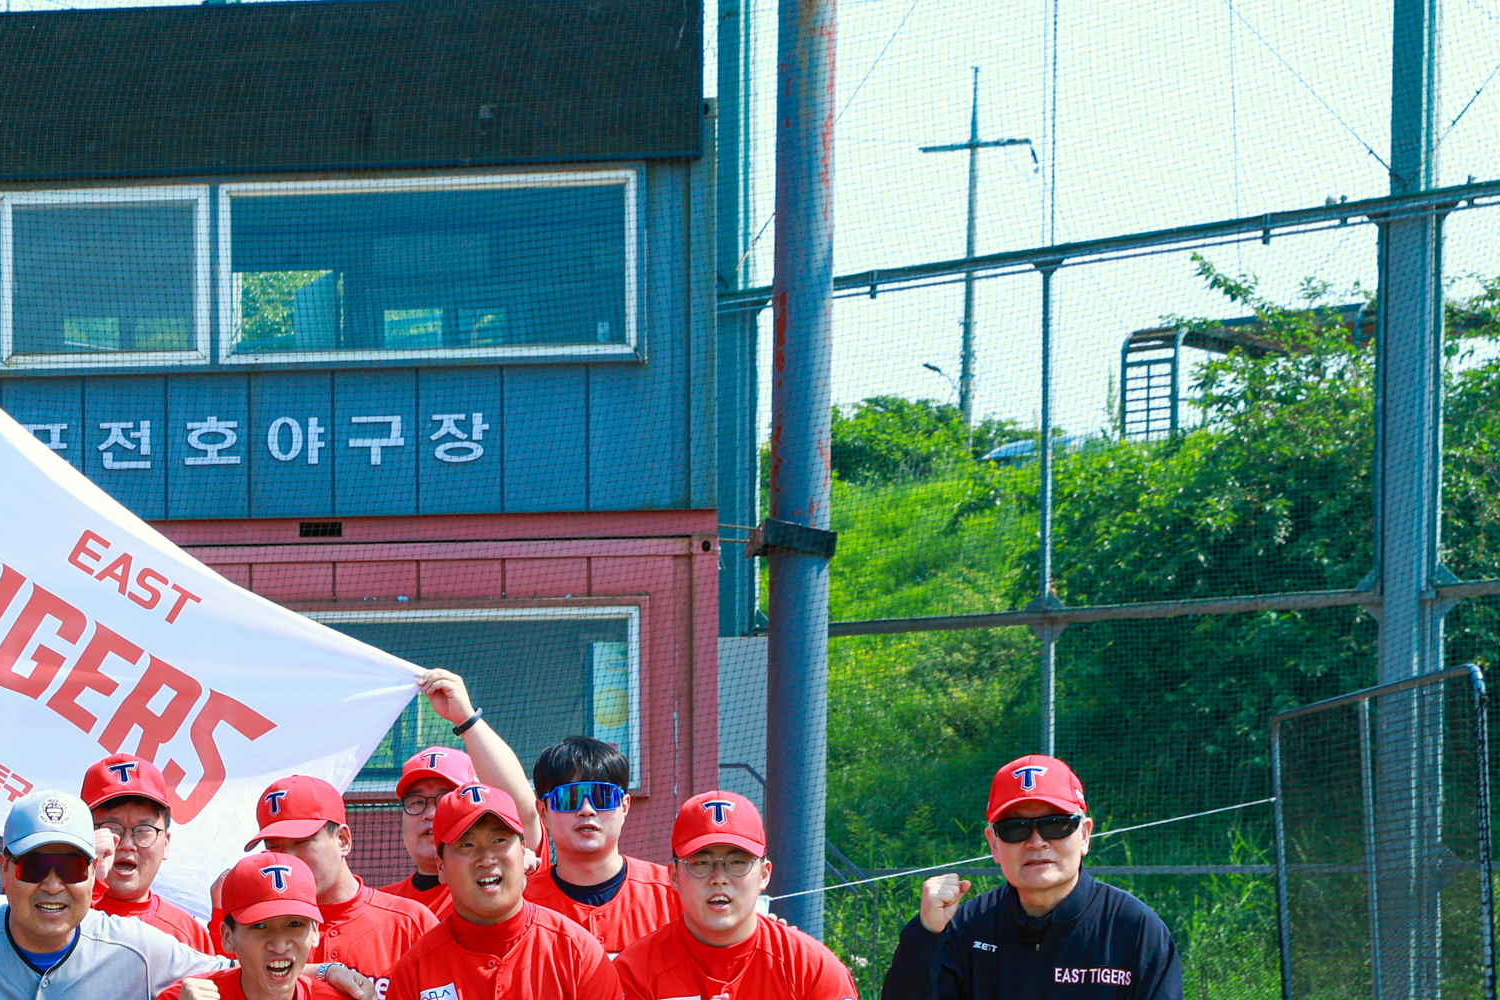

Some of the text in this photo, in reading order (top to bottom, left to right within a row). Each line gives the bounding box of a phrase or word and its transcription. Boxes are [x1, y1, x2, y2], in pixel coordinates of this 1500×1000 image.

[67, 529, 203, 625] EAST
[973, 940, 998, 953] ZETT
[1054, 967, 1131, 986] EAST TIGERS
